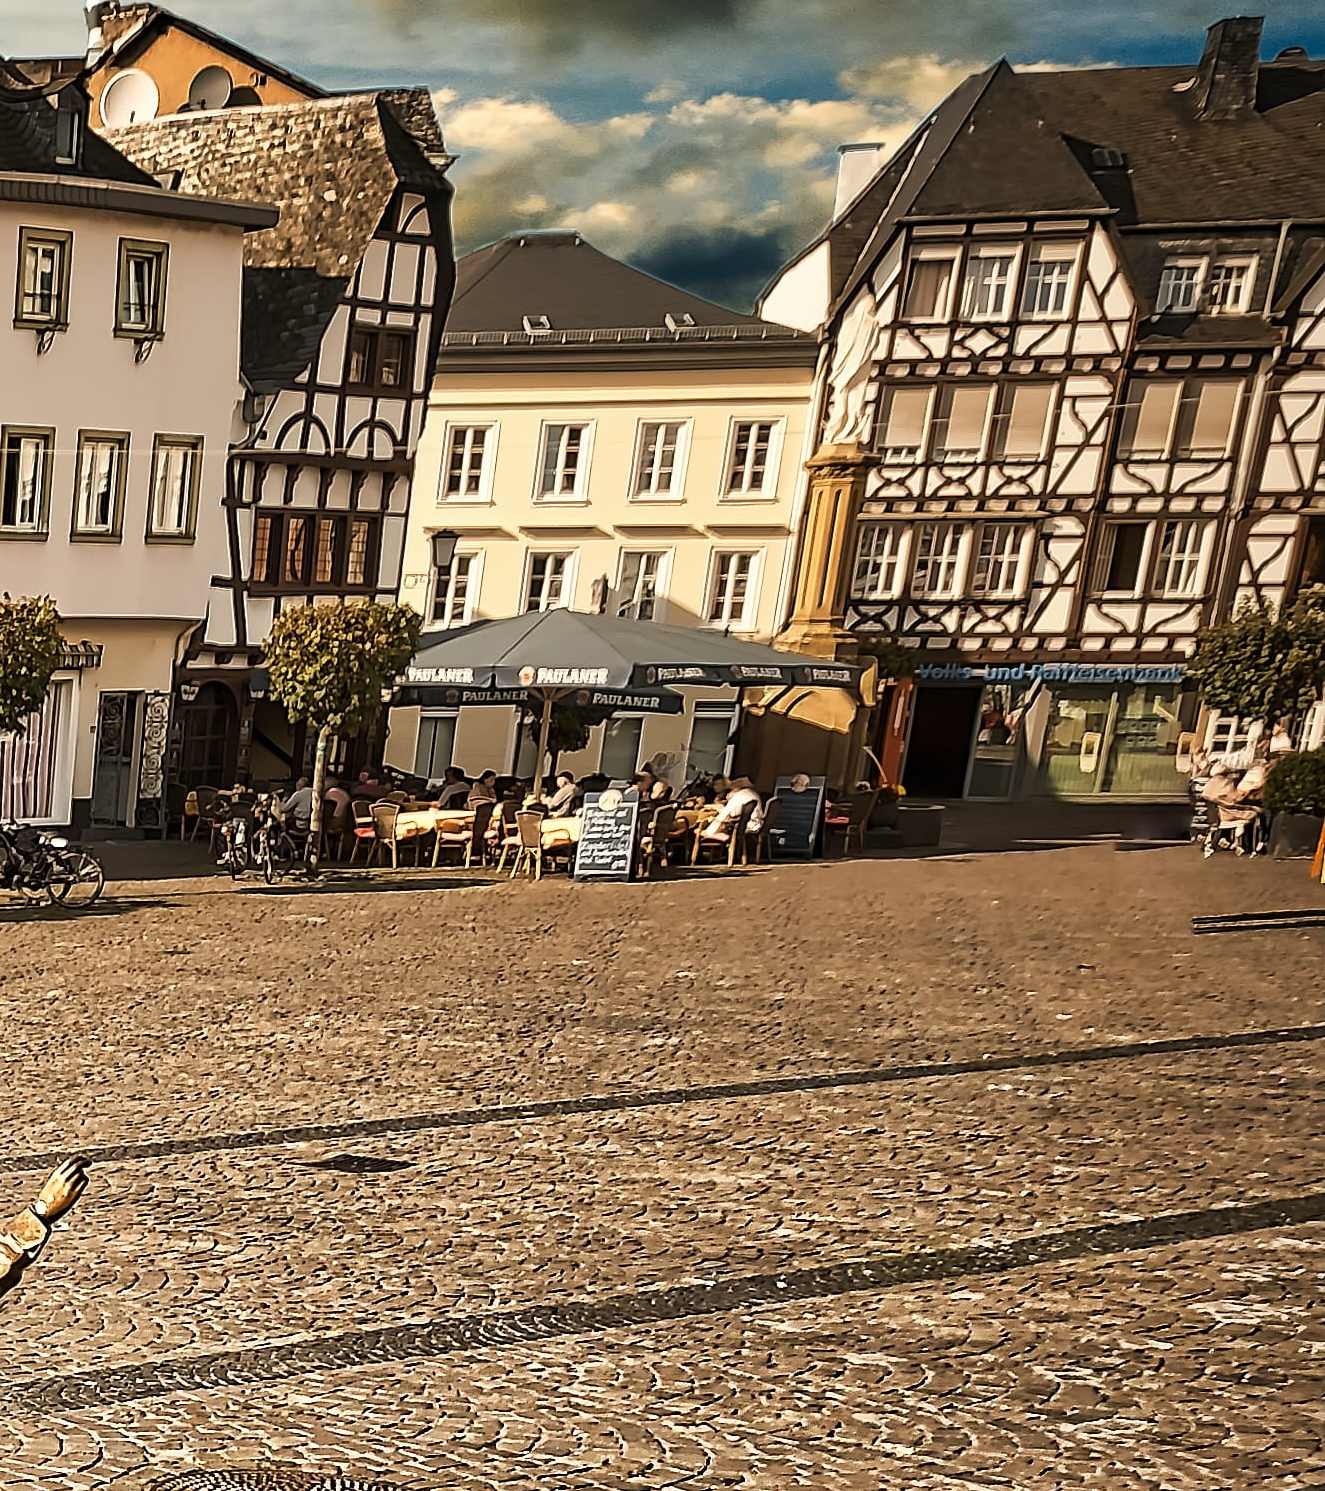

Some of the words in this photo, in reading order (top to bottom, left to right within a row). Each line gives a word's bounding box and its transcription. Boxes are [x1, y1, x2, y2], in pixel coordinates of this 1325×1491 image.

[408, 667, 474, 684] PAULANER
[536, 667, 609, 685] PAULANER
[983, 663, 1025, 681] und
[462, 690, 528, 702] PAULANER
[592, 693, 660, 709] PAULANER
